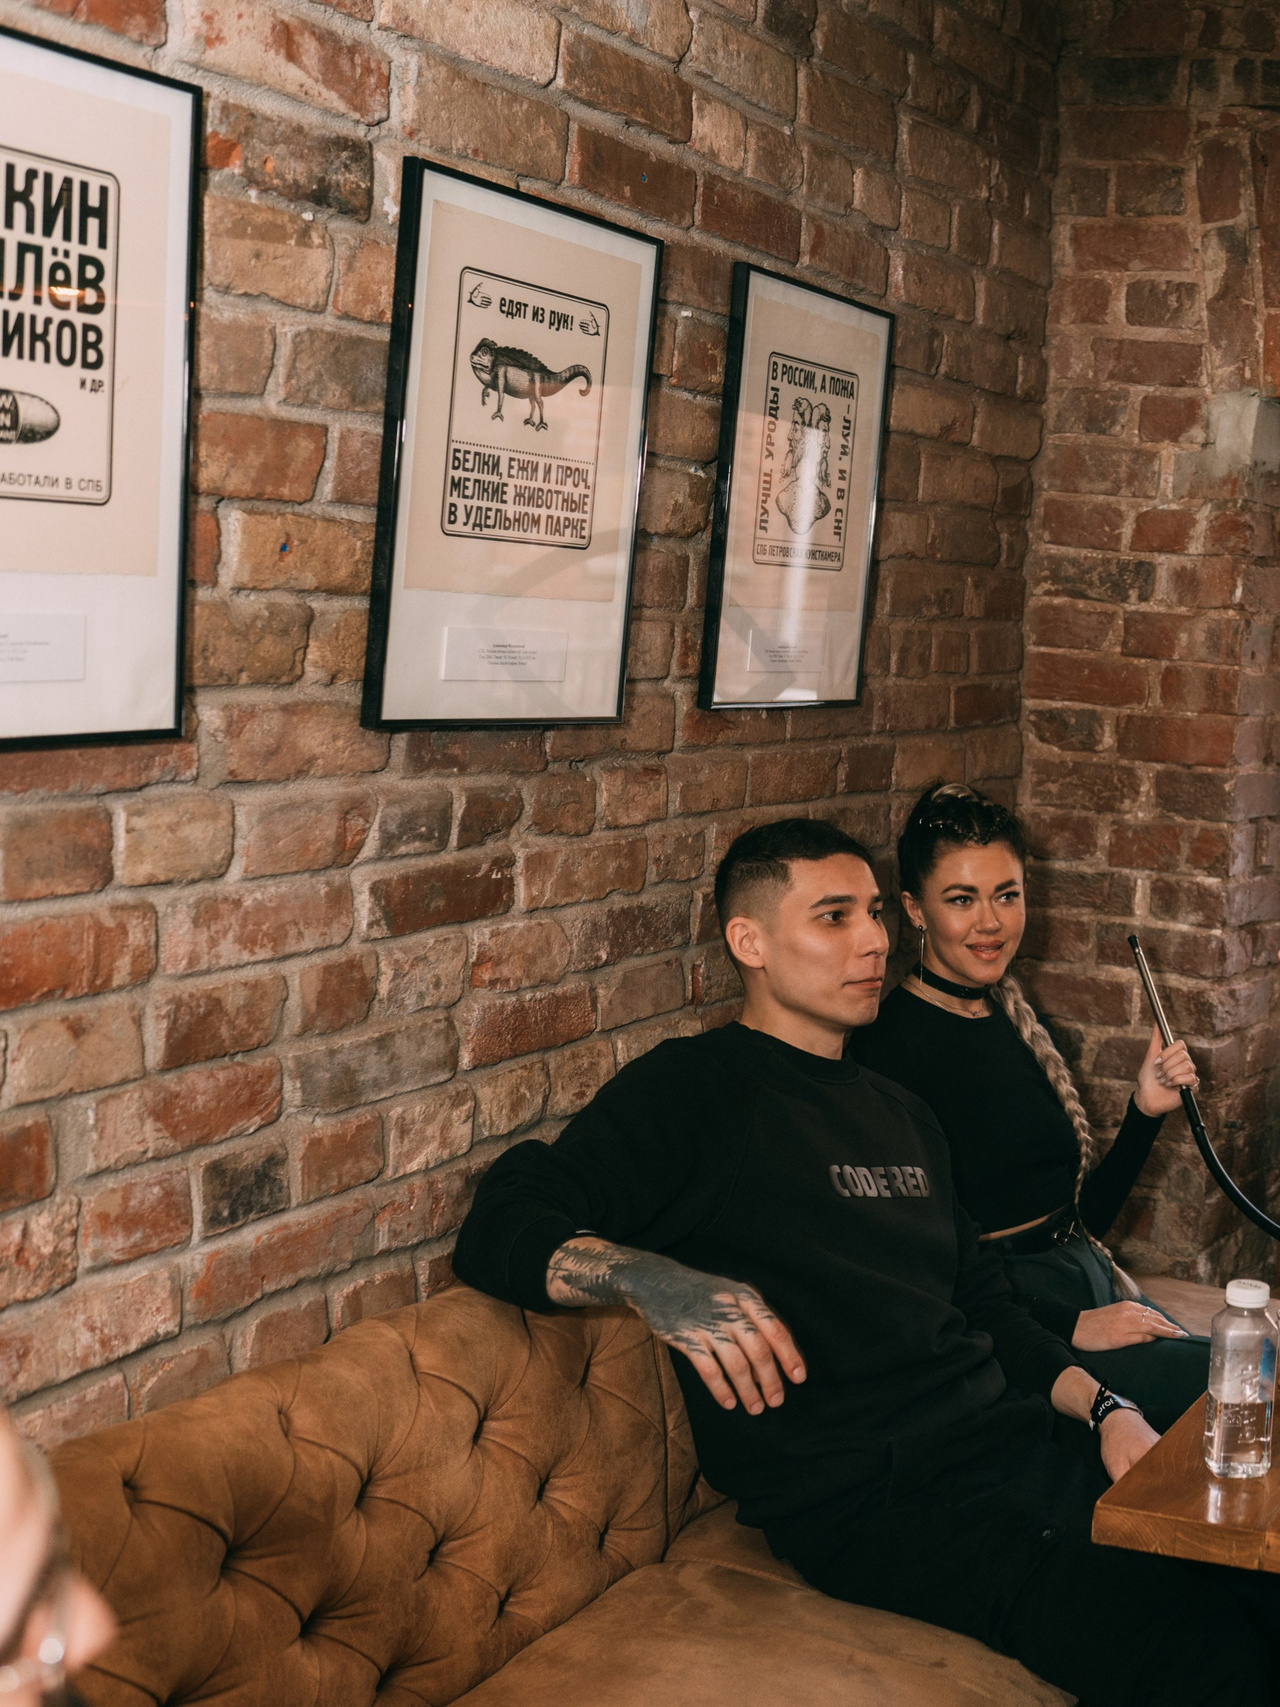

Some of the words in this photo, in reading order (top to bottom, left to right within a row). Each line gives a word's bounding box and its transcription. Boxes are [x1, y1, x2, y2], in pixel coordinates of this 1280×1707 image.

[4, 162, 109, 250] КИН
[1, 309, 105, 370] ИКОВ
[771, 361, 779, 381] В
[780, 363, 818, 394] РОССИИ,
[820, 374, 827, 394] А
[829, 376, 855, 400] ПОЖА
[765, 386, 780, 460] УРОДЫ
[64, 477, 73, 490] В
[78, 478, 104, 493] СПБ
[451, 448, 503, 481] БЕЛКИ,
[507, 457, 540, 483] ЕЖИ
[542, 462, 552, 484] И
[555, 464, 591, 490] ПРОЧ.
[838, 468, 847, 481] И
[449, 475, 509, 505] МЕЛКИЕ
[512, 484, 590, 515] ЖИВОТНЫЕ
[836, 487, 845, 501] В
[447, 502, 458, 525] В
[462, 504, 541, 535] УДЕЛЬНОМ
[544, 514, 587, 540] ПАРКЕ
[833, 507, 844, 542] СНГ
